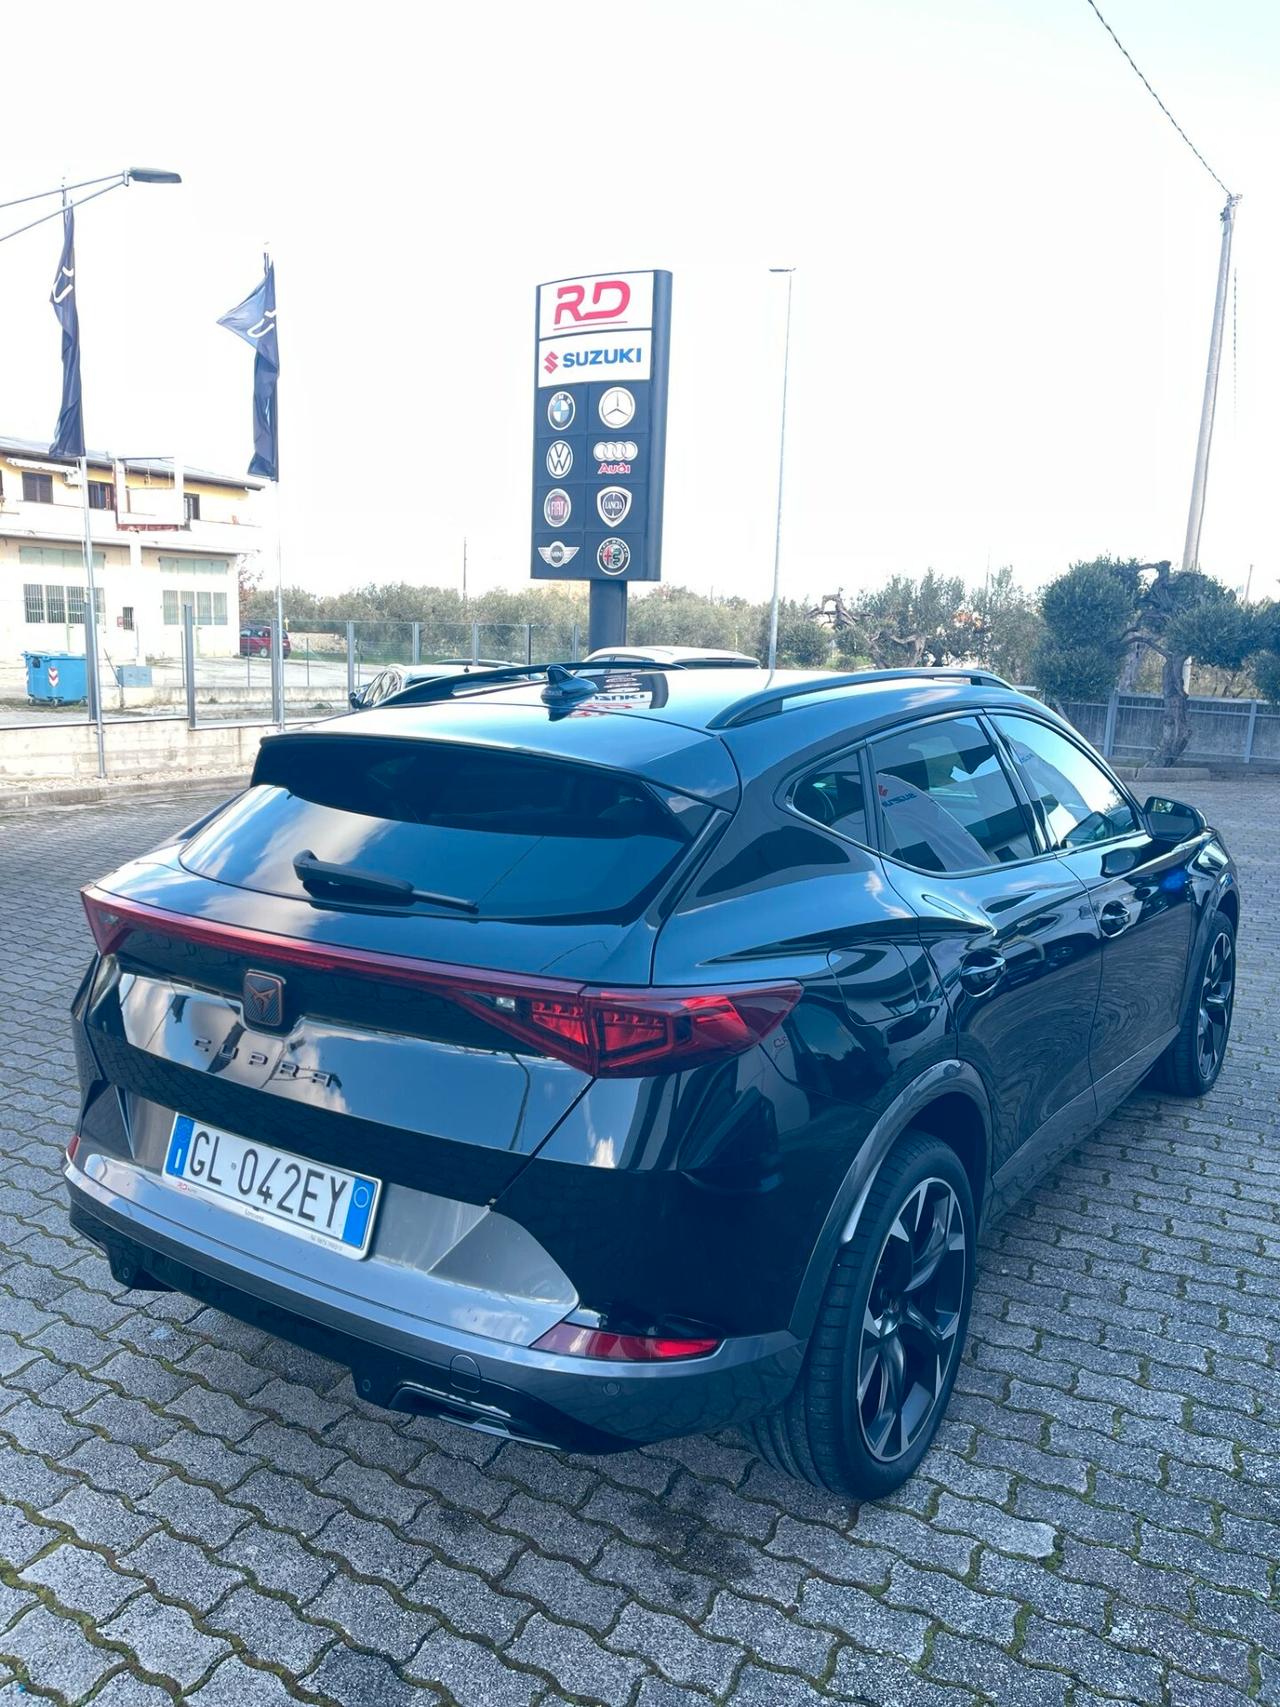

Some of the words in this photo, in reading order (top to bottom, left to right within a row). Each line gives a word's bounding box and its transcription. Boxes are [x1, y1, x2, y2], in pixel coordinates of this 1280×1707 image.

[554, 280, 631, 325] RD
[562, 347, 642, 368] SUZUKI
[189, 1131, 223, 1186] GL
[238, 1149, 347, 1228] 042EY
